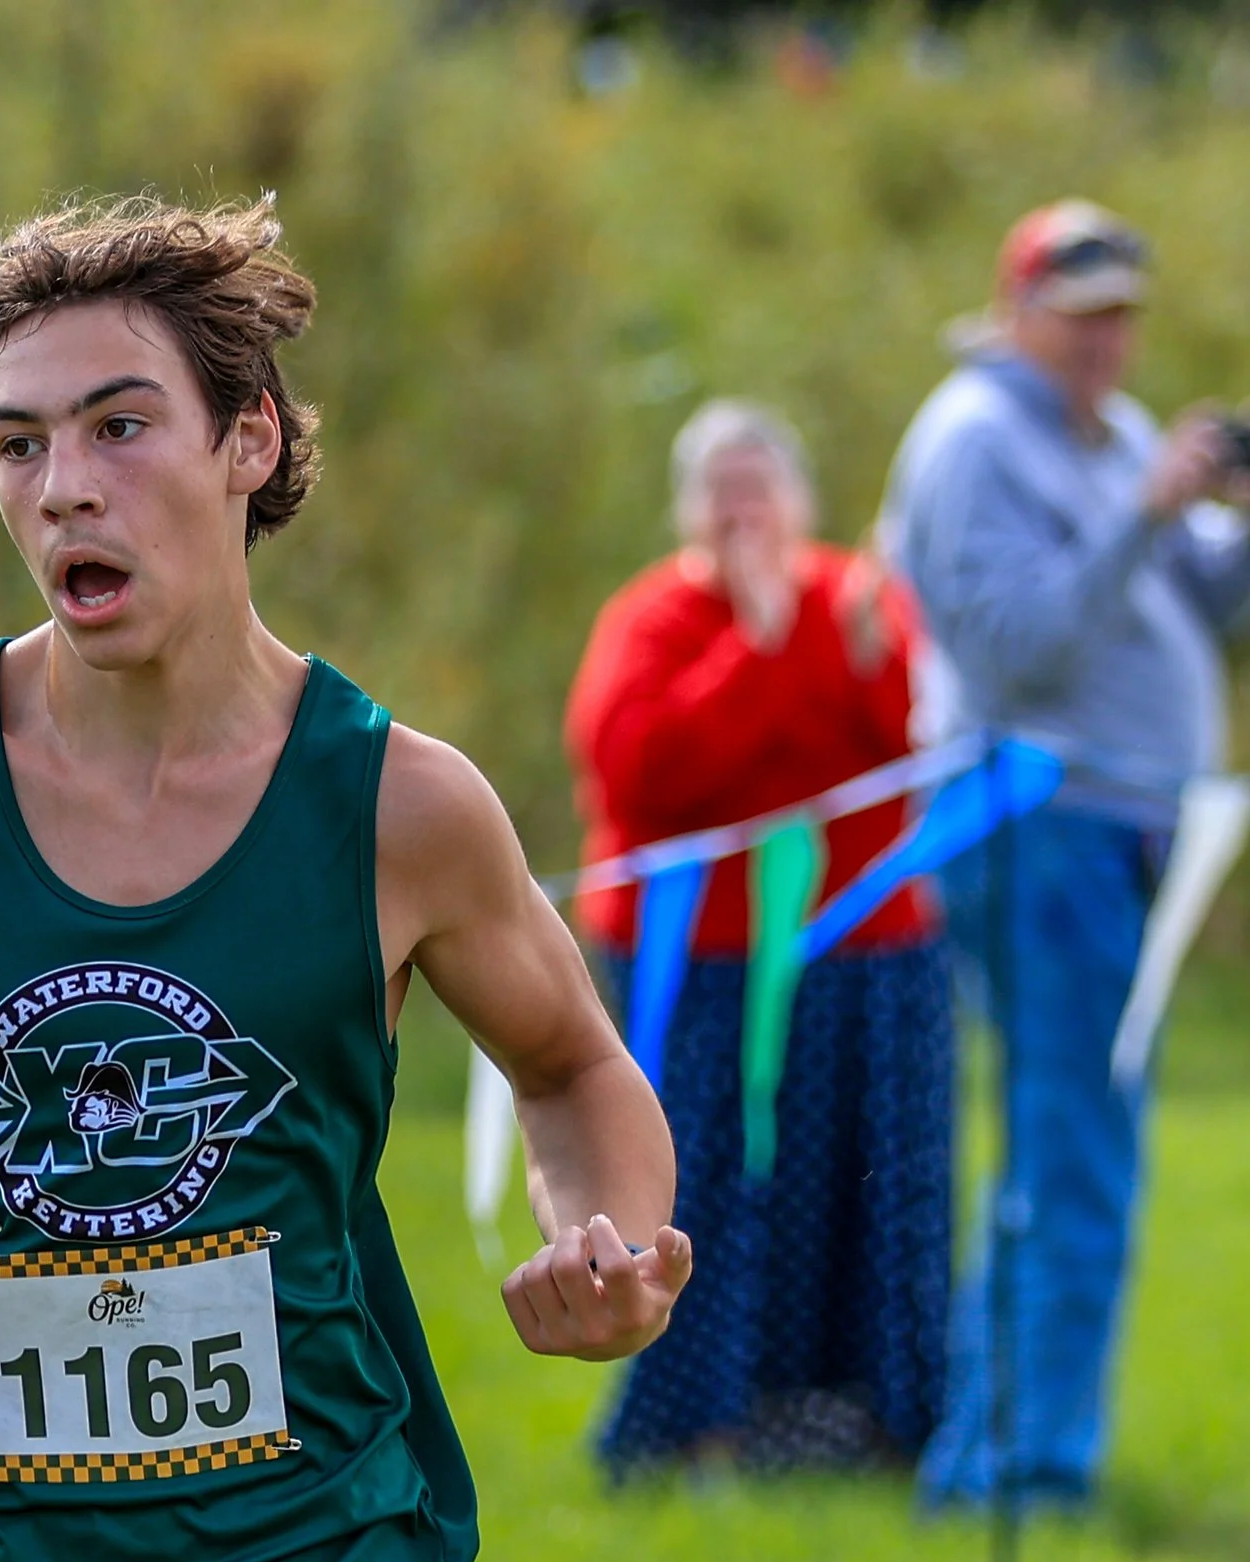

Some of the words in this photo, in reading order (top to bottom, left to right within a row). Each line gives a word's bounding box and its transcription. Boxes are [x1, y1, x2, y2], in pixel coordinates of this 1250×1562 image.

[10, 1144, 220, 1238] KETTERING
[88, 1291, 145, 1325] Ope!
[0, 1331, 251, 1438] 1165
